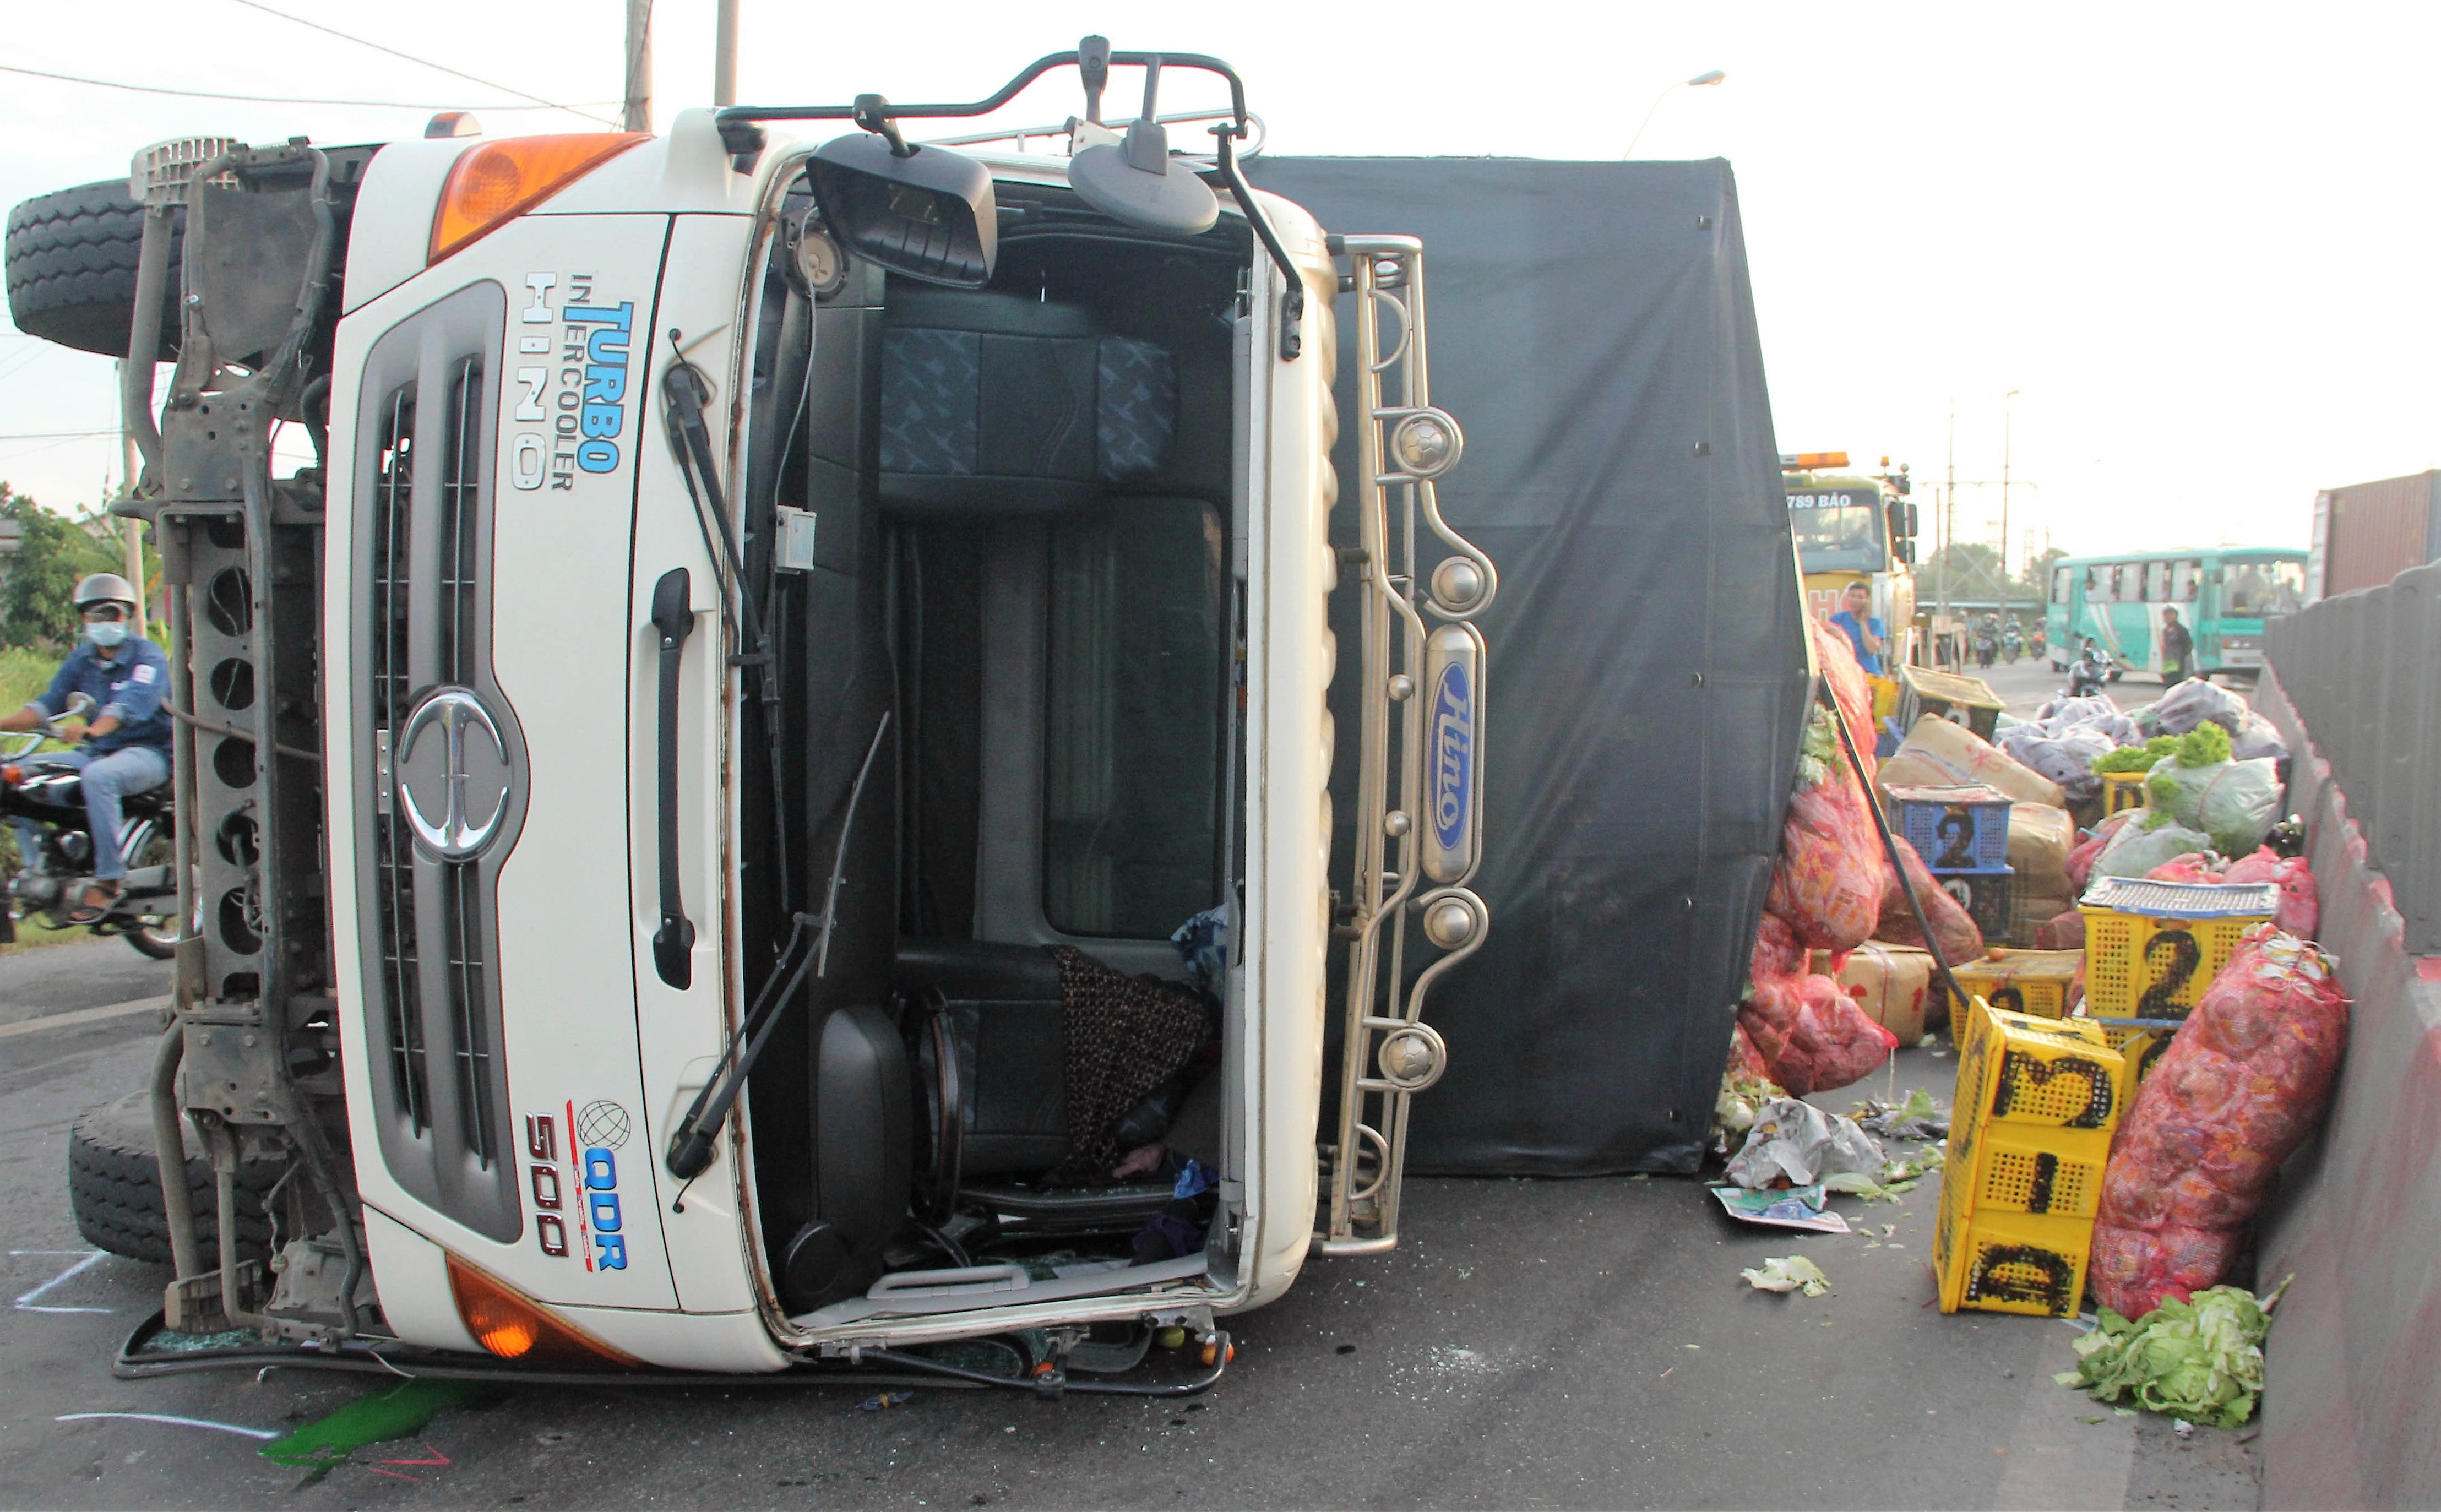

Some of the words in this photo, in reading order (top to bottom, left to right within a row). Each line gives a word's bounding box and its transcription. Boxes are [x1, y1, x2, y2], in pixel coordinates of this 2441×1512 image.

[512, 271, 557, 491] HINO
[563, 300, 635, 474] TURBO
[1436, 681, 1470, 830] Hino
[1936, 813, 1977, 868] 2
[2137, 929, 2201, 1021] 2
[526, 1111, 570, 1258] 500
[585, 1147, 628, 1271] QDR
